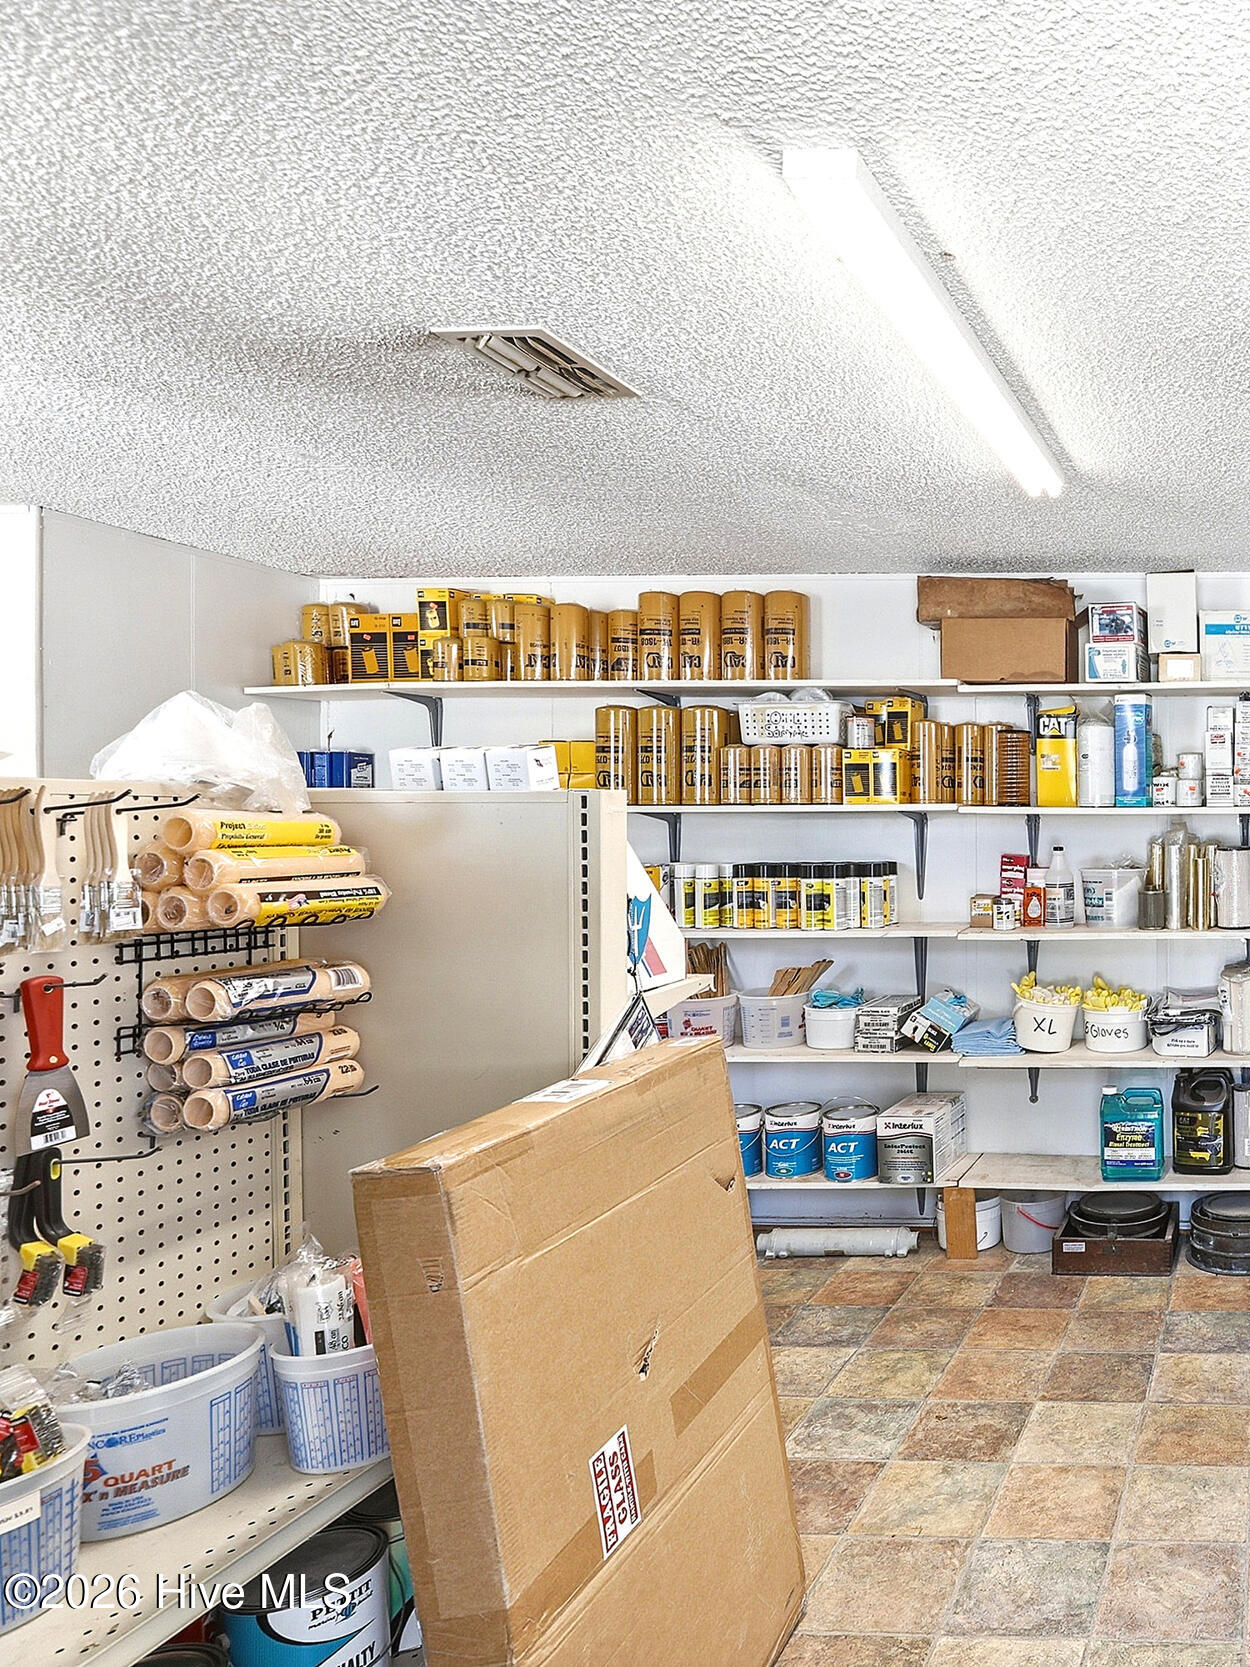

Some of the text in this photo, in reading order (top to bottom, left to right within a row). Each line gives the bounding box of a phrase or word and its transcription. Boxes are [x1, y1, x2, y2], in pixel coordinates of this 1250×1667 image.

[1039, 717, 1067, 735] CAT
[220, 821, 246, 831] Project
[1032, 1016, 1058, 1035] XL
[1090, 1022, 1129, 1039] Gloves
[891, 1122, 924, 1130] Interlux
[769, 1138, 800, 1150] ACT
[828, 1142, 859, 1153] ACT
[103, 1458, 177, 1488] QUART
[114, 1465, 191, 1499] MEASURE
[609, 1451, 628, 1525] GLASS
[594, 1456, 618, 1550] FRAGILE
